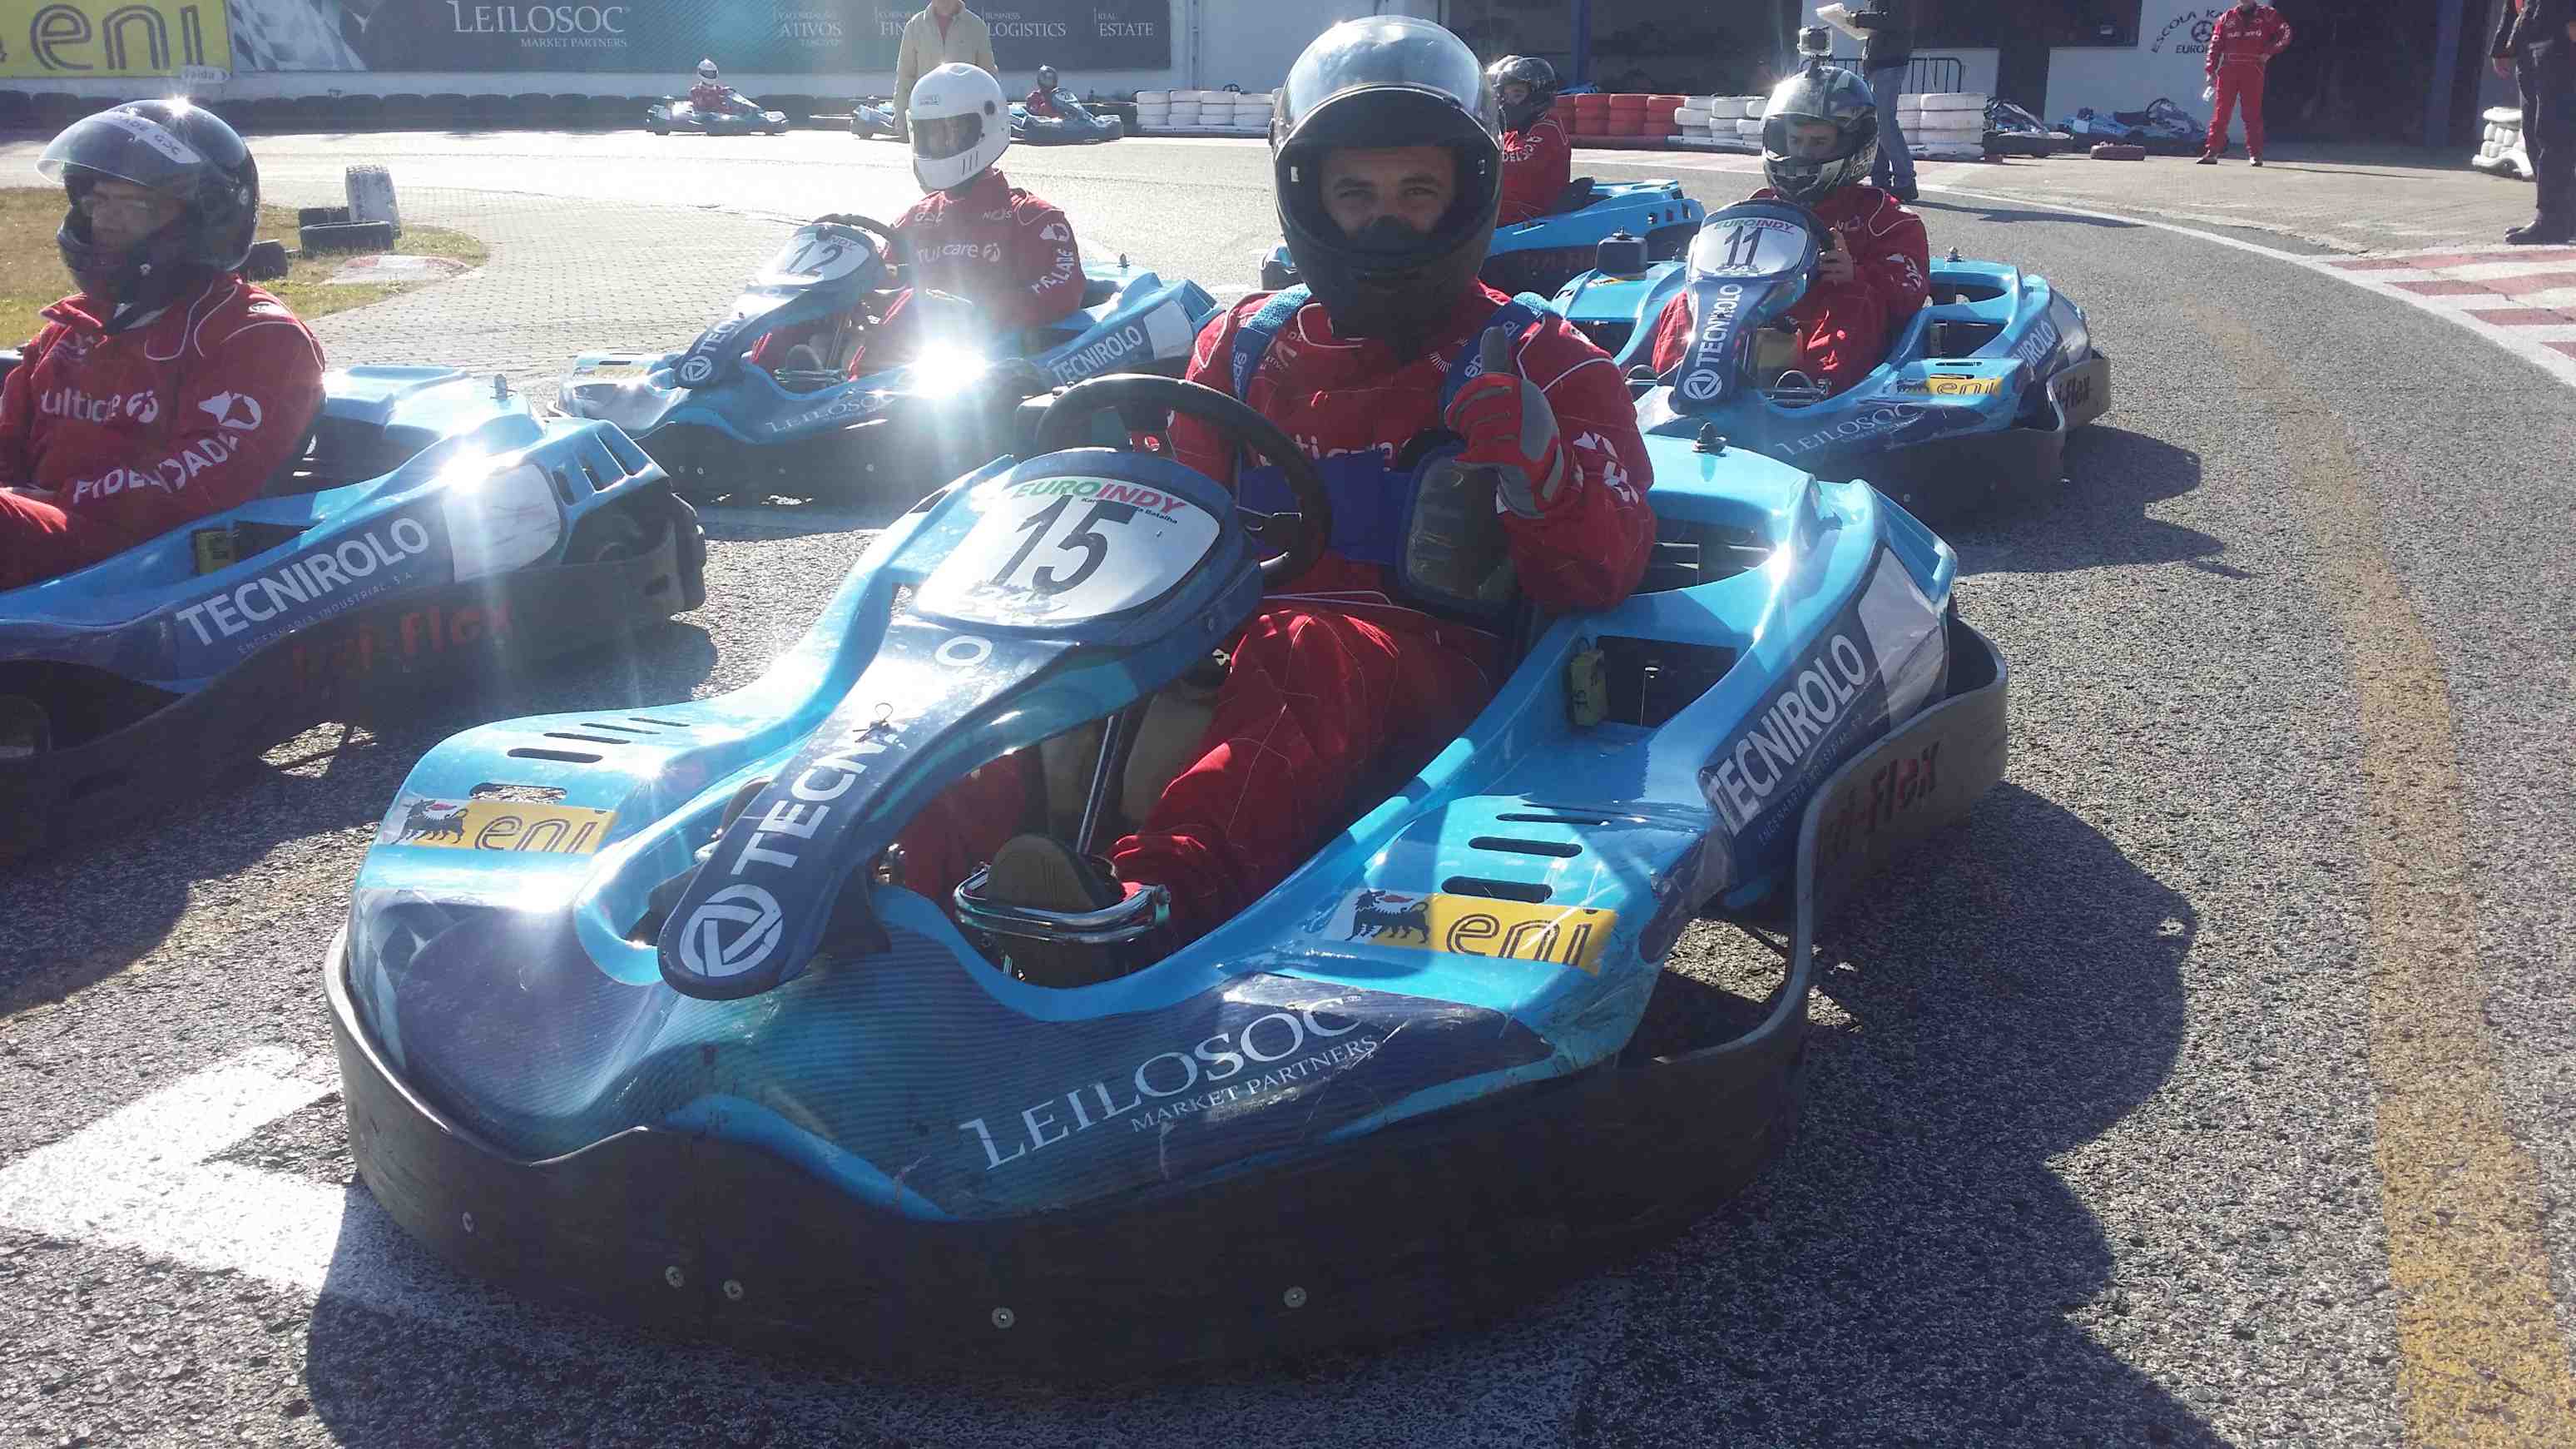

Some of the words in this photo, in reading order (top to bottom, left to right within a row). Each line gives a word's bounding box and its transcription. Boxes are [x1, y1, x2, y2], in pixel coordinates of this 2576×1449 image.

[30, 3, 206, 71] eni
[446, 0, 626, 33] LEILOSOC
[987, 22, 1066, 37] LOGISTICS
[1099, 22, 1154, 37] ESTATE
[521, 38, 567, 47] MARKET
[571, 38, 627, 47] PARTNERS
[2176, 45, 2208, 53] EURO
[785, 240, 845, 277] 12
[1724, 226, 1763, 267] 11
[1052, 325, 1142, 387] TECNIROLO
[1775, 403, 1918, 455] LEILOSOC
[1013, 479, 1186, 514] EUROINDY
[991, 494, 1134, 596] 15
[175, 518, 429, 647] TECNIROLO
[1708, 635, 1865, 837] TECNIROLO
[474, 810, 606, 853] eni
[1446, 909, 1598, 965] eni
[959, 997, 1361, 1170] LEILOSOC
[1131, 1084, 1239, 1133] MARKET
[1245, 1034, 1379, 1095] PARTNERS
